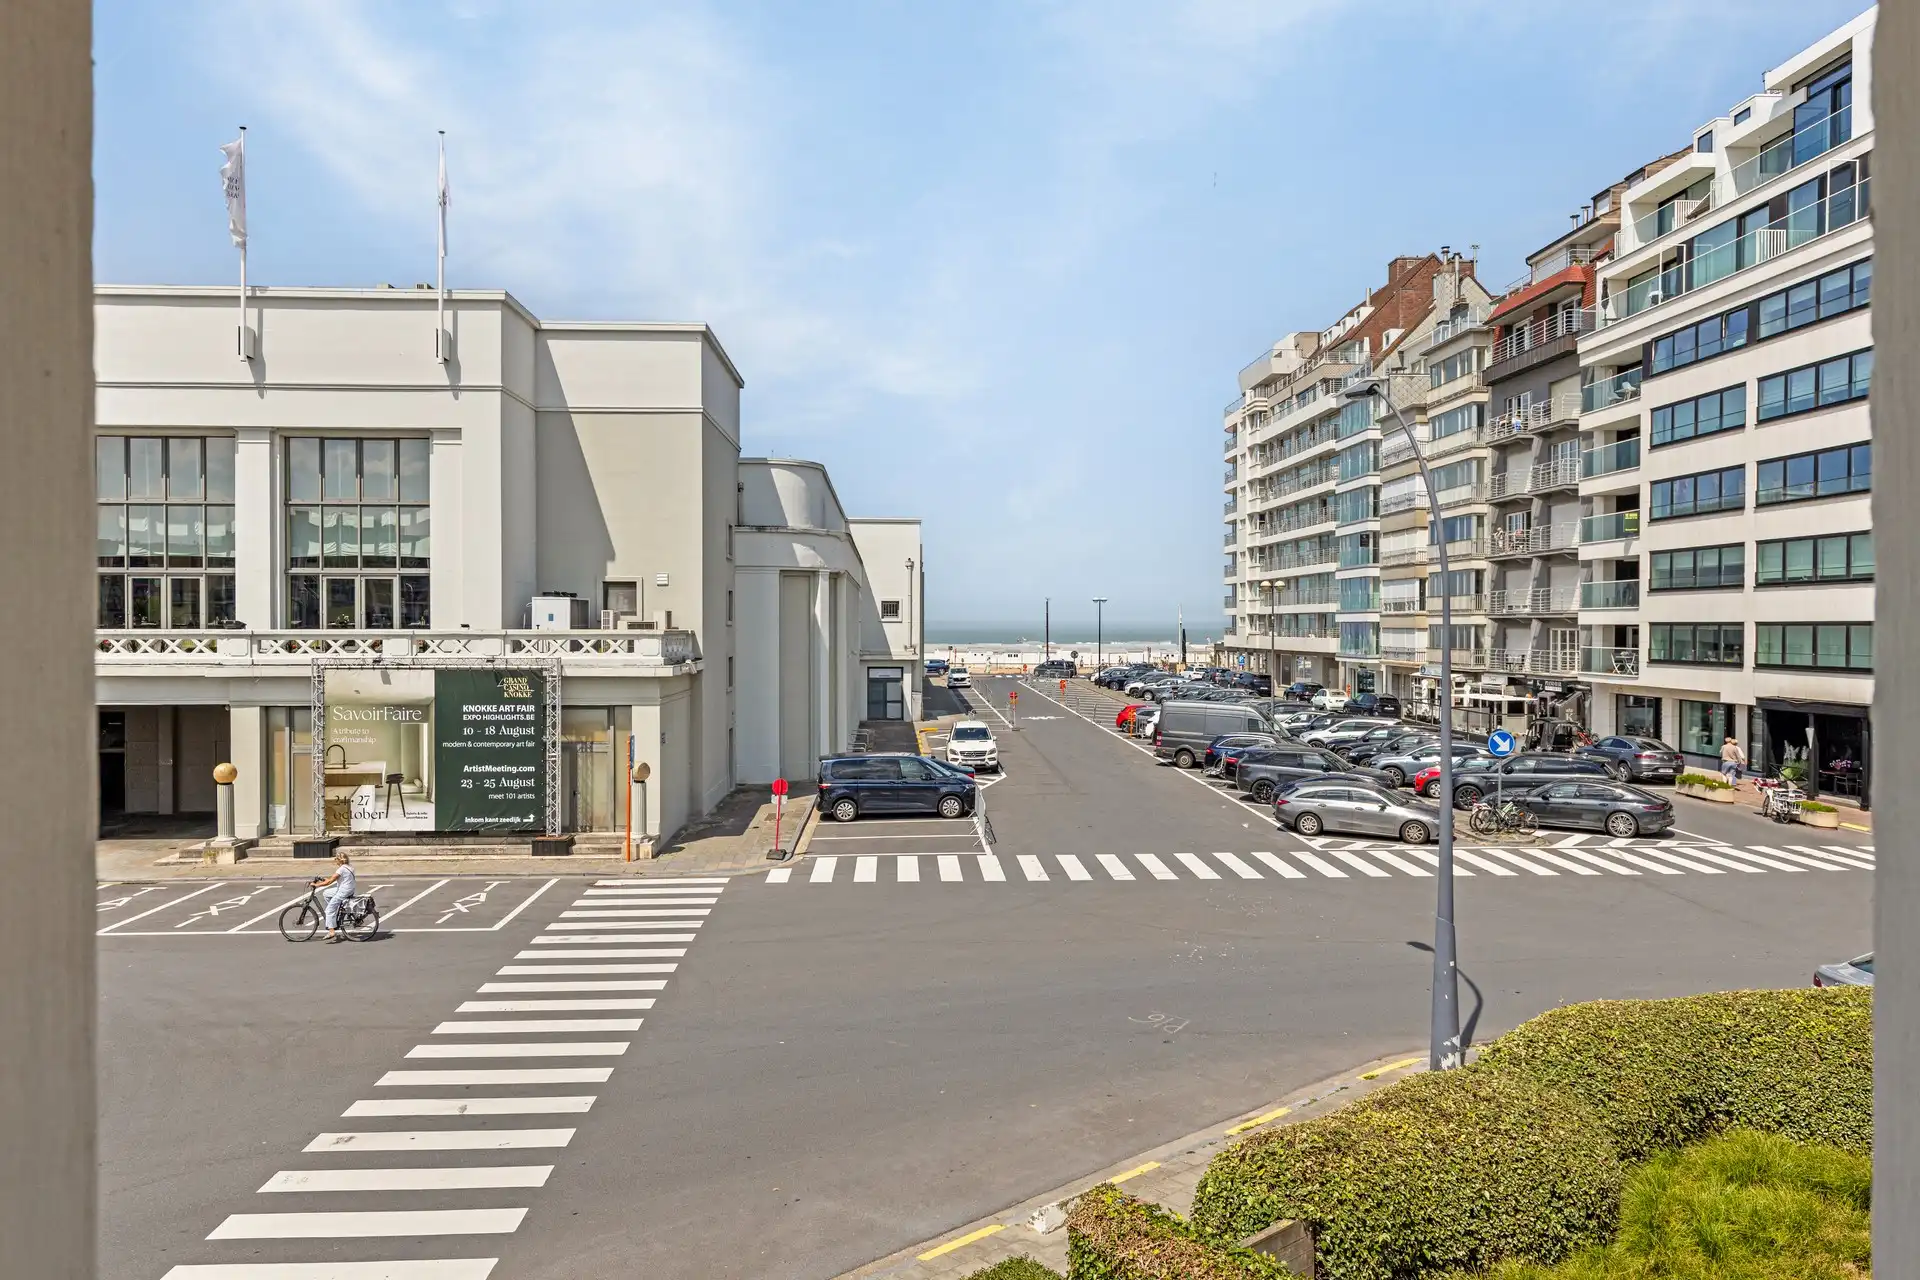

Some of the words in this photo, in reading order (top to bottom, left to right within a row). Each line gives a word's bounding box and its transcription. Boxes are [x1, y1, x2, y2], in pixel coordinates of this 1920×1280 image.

[462, 704, 498, 712] KNOKKE
[498, 704, 515, 712] ART
[516, 704, 535, 712] FAIR
[463, 727, 474, 736] 10
[484, 726, 496, 736] 18
[498, 725, 535, 738] August
[463, 764, 535, 774] ArtistMeeting.com
[461, 779, 473, 788] 23
[483, 779, 496, 788] 25
[498, 777, 535, 790] August
[357, 795, 370, 806] 27
[333, 808, 384, 820] october
[174, 886, 283, 928] TAXI
[434, 881, 511, 924] TAXI
